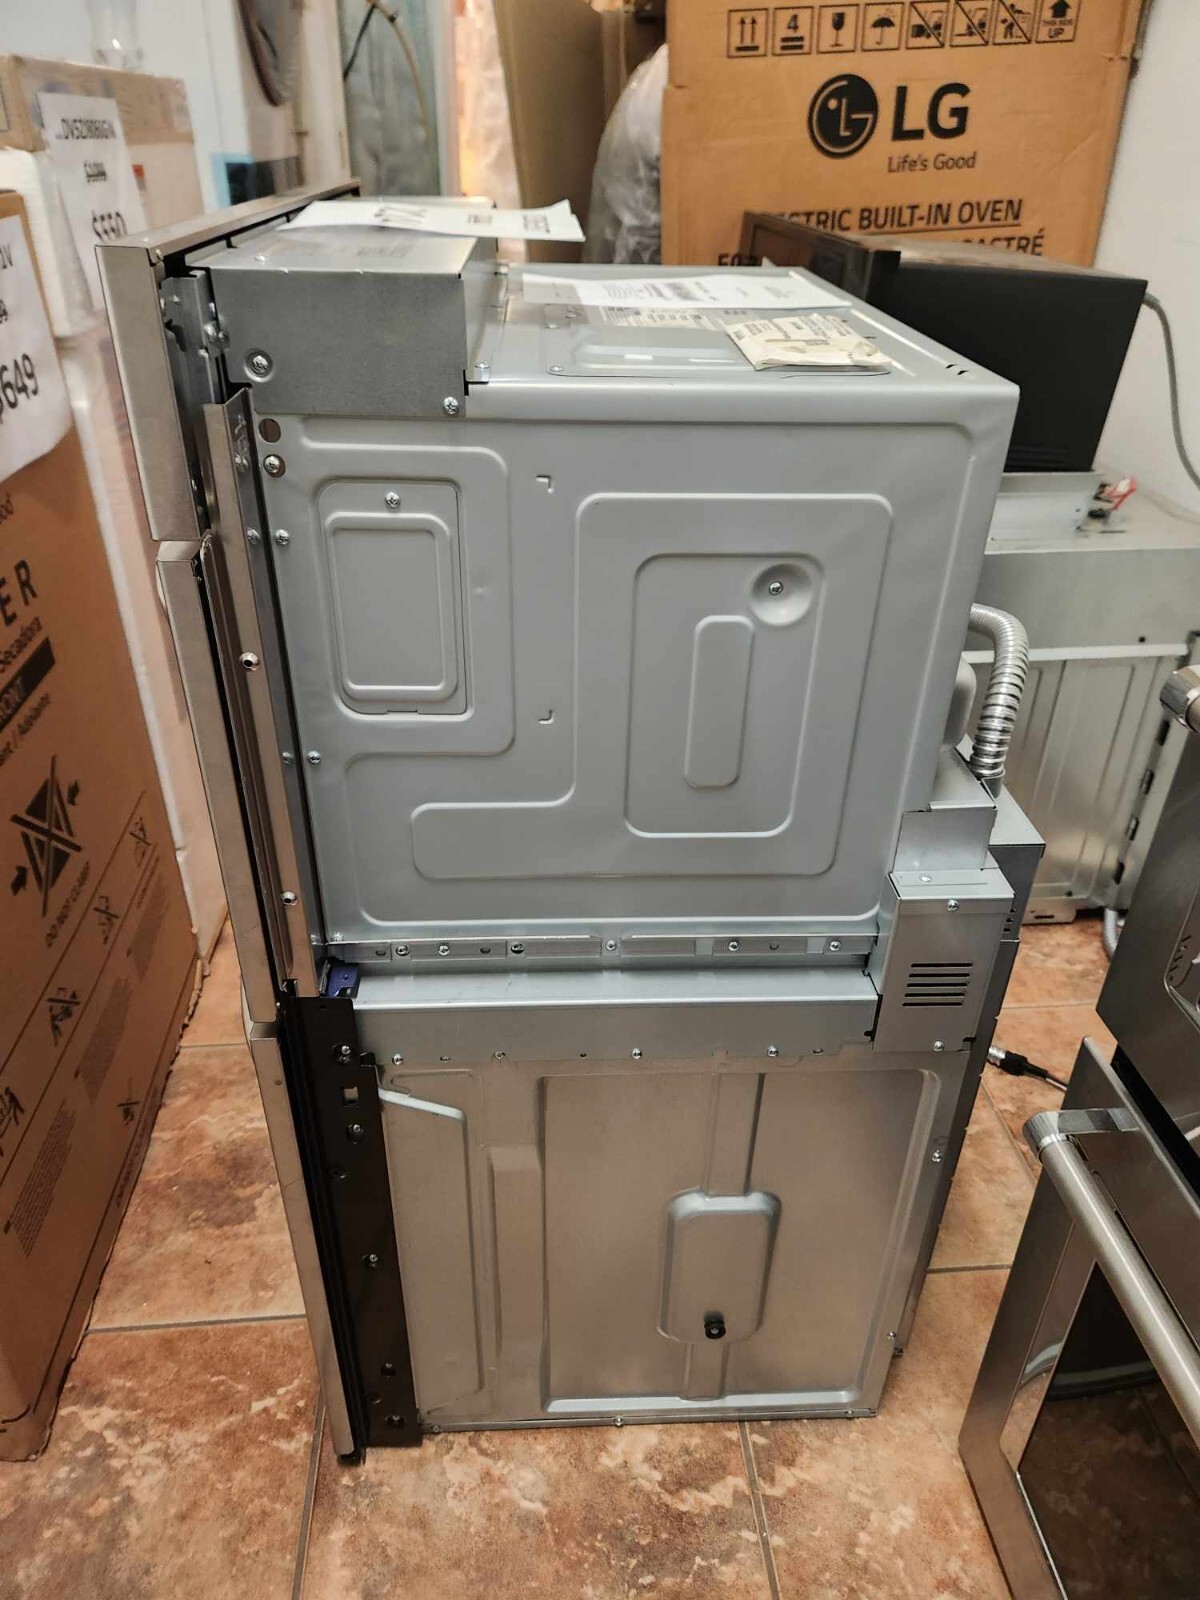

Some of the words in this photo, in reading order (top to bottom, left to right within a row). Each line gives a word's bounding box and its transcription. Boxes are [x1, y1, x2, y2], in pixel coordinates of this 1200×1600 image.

[786, 14, 799, 34] 4
[891, 82, 971, 142] LG
[887, 155, 928, 174] Life's
[932, 152, 977, 171] Good
[858, 203, 952, 231] BUILT-IN
[957, 198, 1023, 225] OVEN
